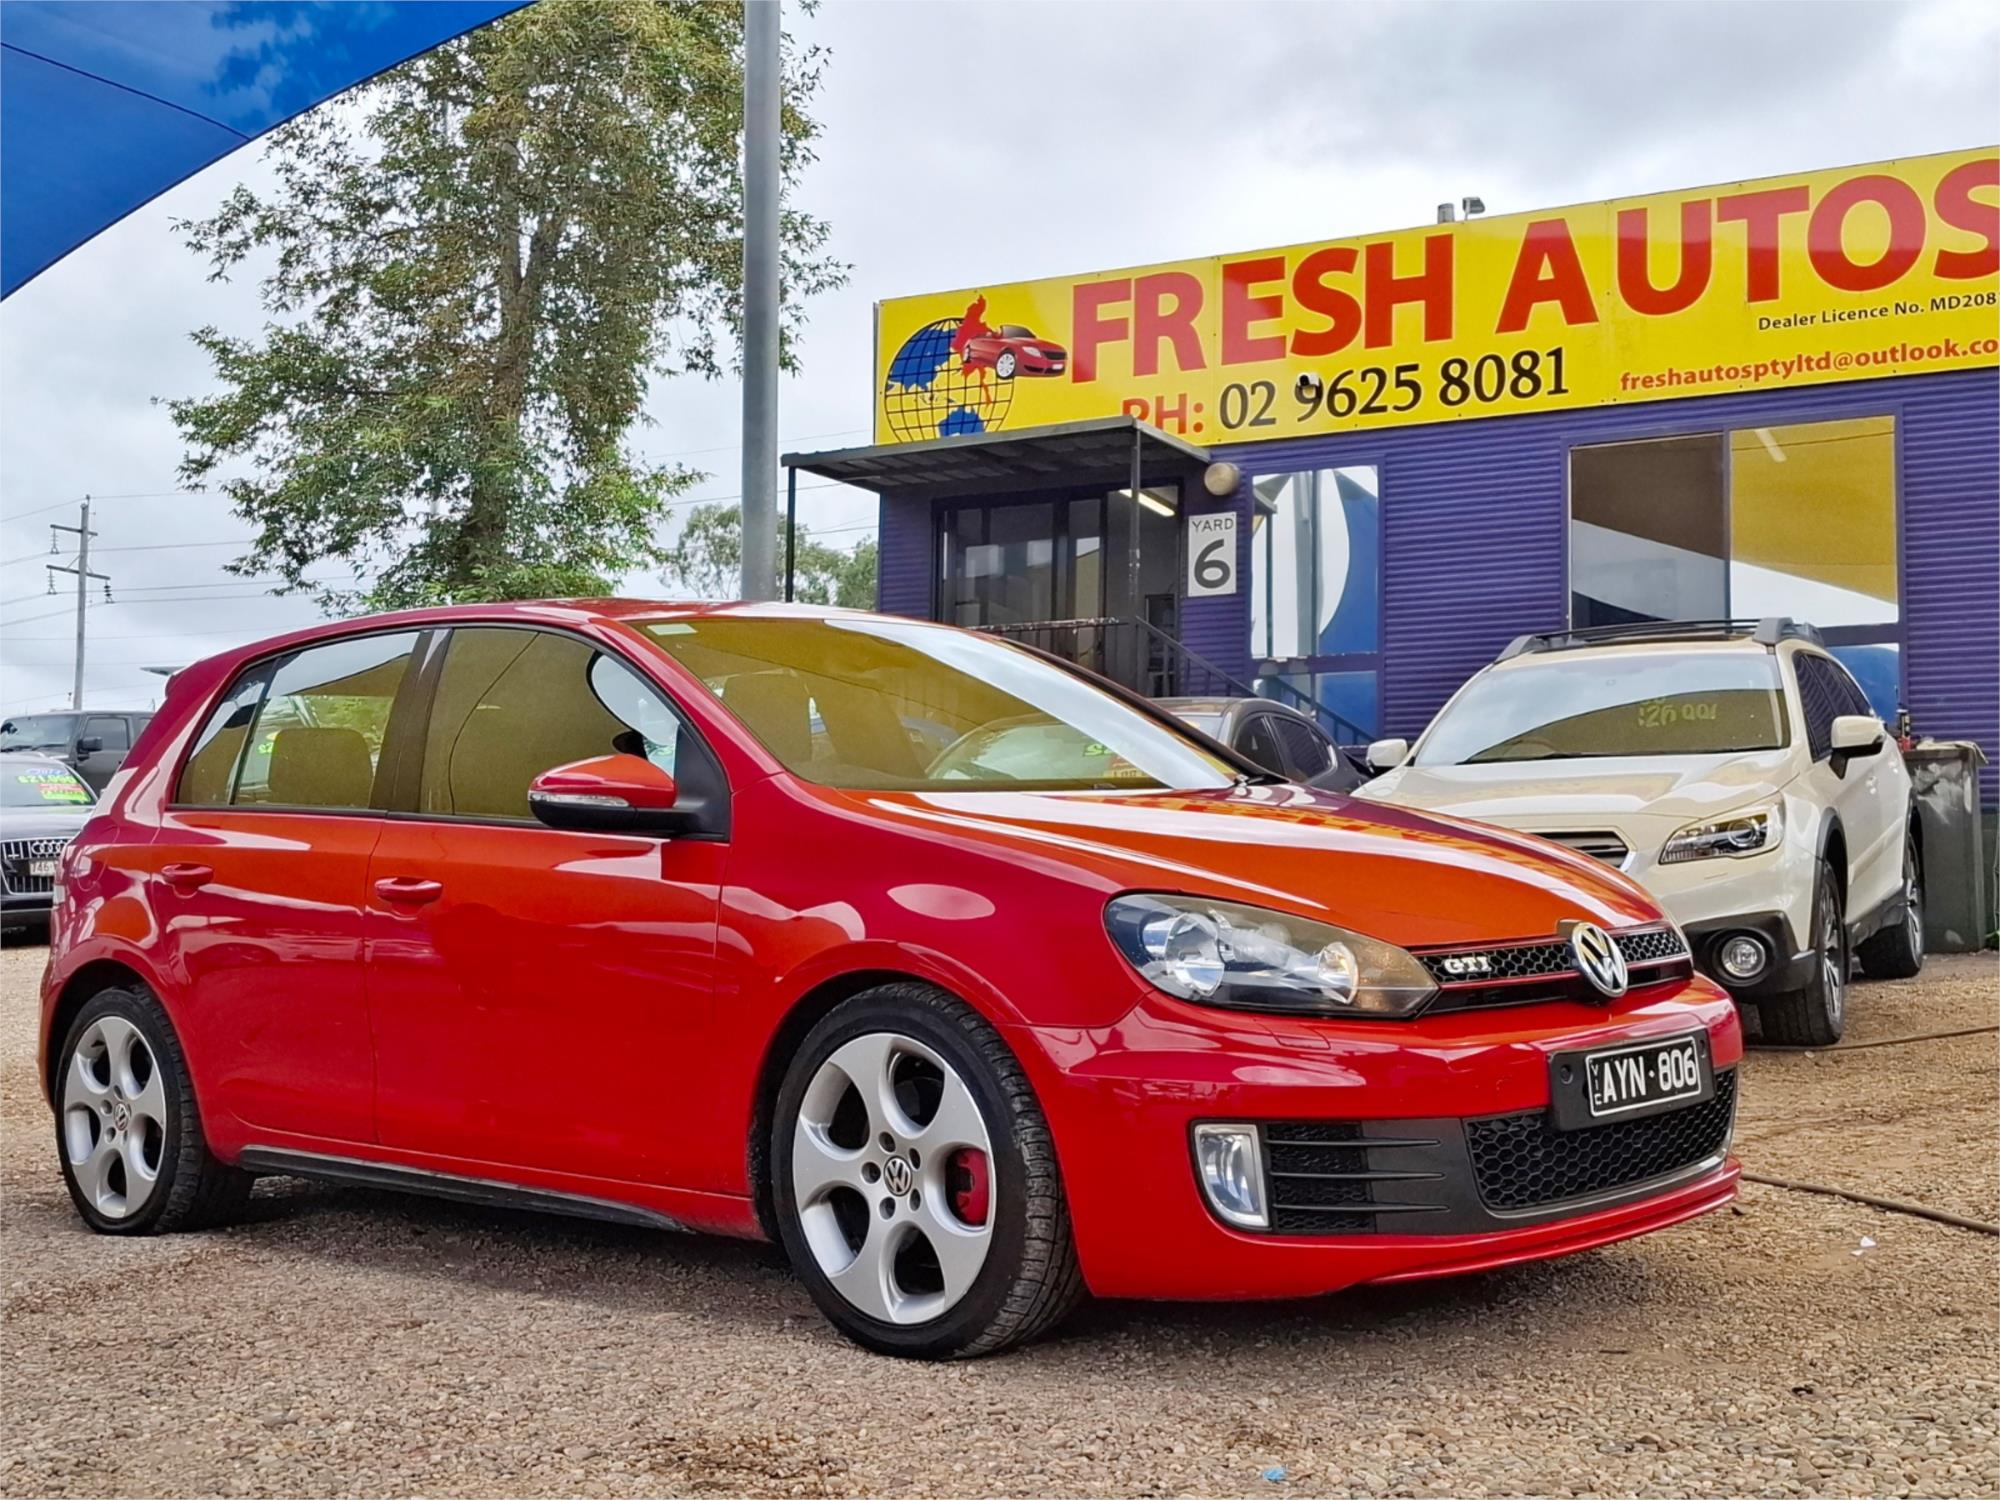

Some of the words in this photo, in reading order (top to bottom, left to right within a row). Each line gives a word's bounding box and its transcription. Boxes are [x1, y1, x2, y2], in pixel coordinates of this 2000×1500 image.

[1072, 234, 1454, 384] FRESH
[1494, 159, 2000, 335] AUTOS
[1758, 313, 1816, 330] Dealer
[1821, 307, 1889, 324] Licence
[1894, 301, 1925, 315] No.
[1219, 380, 1277, 431] 02
[1294, 363, 1423, 423] 9625
[1440, 347, 1569, 408] 8081
[1192, 518, 1235, 533] YARD
[1194, 539, 1231, 589] 6
[1443, 956, 1492, 975] GTI
